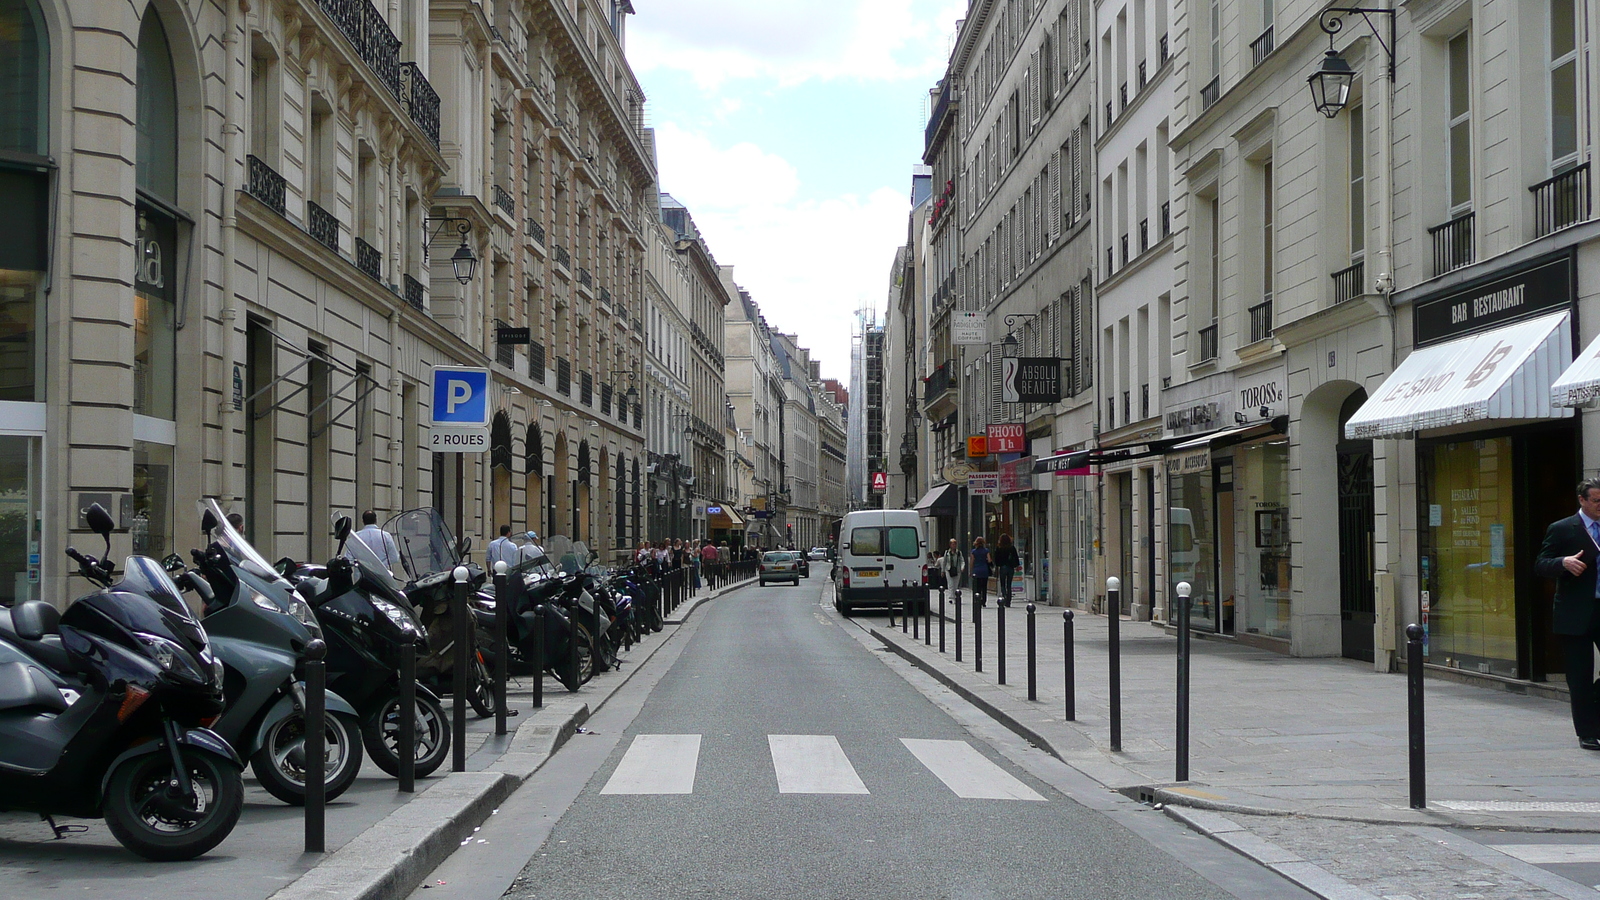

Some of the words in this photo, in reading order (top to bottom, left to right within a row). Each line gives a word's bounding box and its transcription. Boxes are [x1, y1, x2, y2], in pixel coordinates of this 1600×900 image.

[1452, 302, 1468, 324] BAR
[1473, 283, 1525, 318] RESTAURANT
[1022, 365, 1057, 380] ABSOLU
[446, 379, 472, 413] P
[1022, 380, 1057, 394] BEAUTE
[1240, 381, 1277, 410] TOROSS
[1382, 381, 1411, 402] LE
[432, 434, 440, 445] 2
[444, 434, 484, 445] ROUES
[988, 425, 1023, 438] PHOTO
